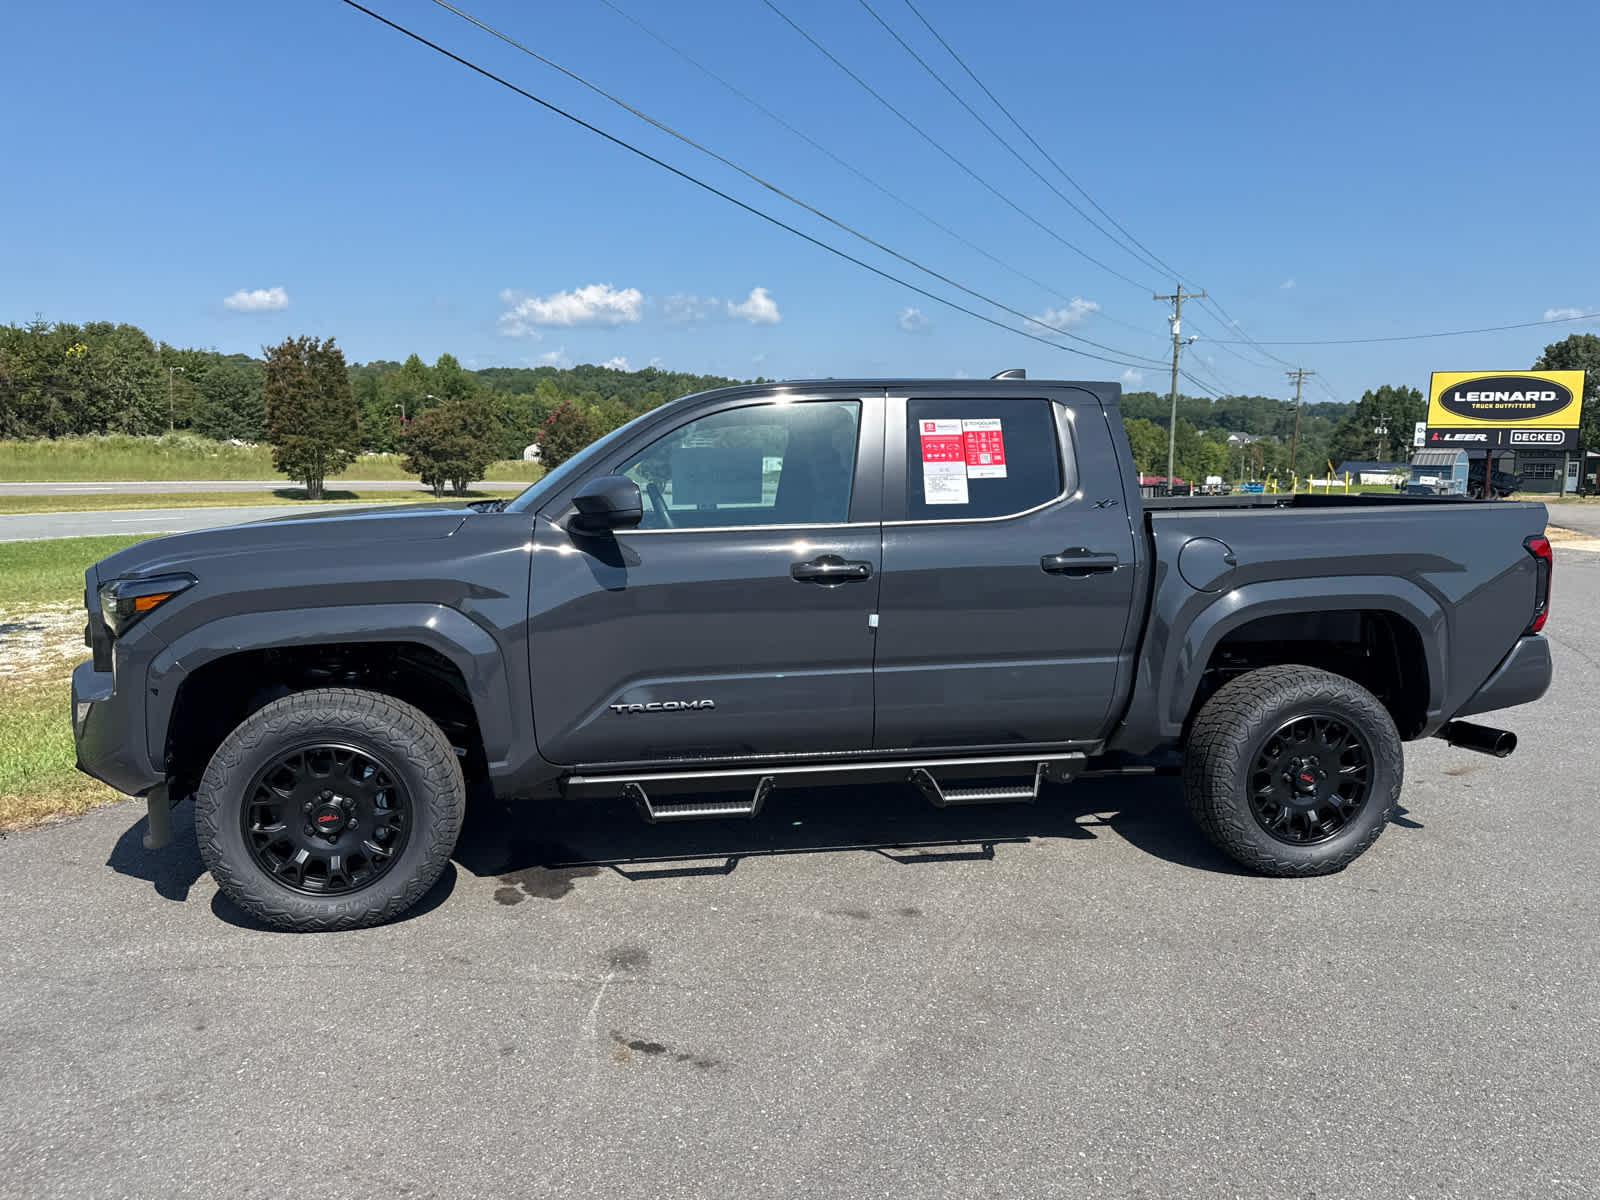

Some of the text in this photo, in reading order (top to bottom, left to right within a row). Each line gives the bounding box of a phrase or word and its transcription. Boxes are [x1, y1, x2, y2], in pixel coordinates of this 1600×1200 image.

[1454, 391, 1556, 401] LEONARD
[1443, 433, 1488, 442] LEER
[1514, 433, 1561, 441] DECKED
[609, 699, 716, 714] TACOMA
